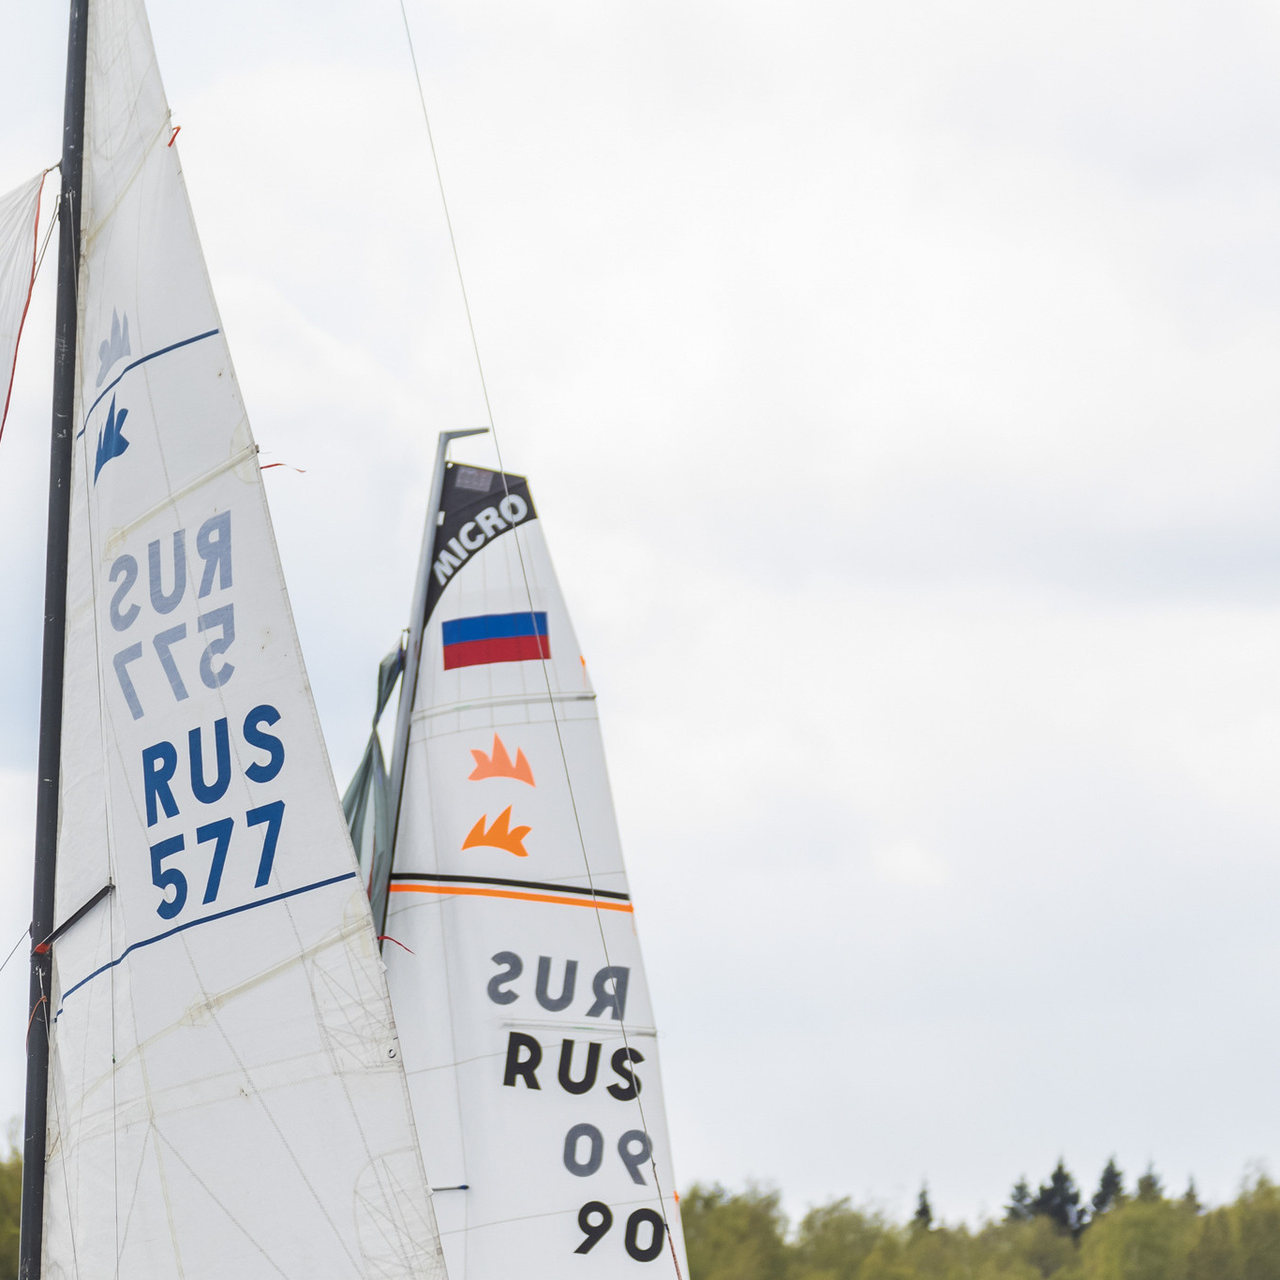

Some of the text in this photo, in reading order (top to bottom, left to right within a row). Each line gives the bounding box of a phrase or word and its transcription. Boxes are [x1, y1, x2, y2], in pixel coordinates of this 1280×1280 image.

[433, 494, 528, 586] MICRO
[142, 705, 286, 827] RUS
[150, 800, 286, 920] 577
[503, 1031, 645, 1102] RUS
[573, 1201, 666, 1263] 90
